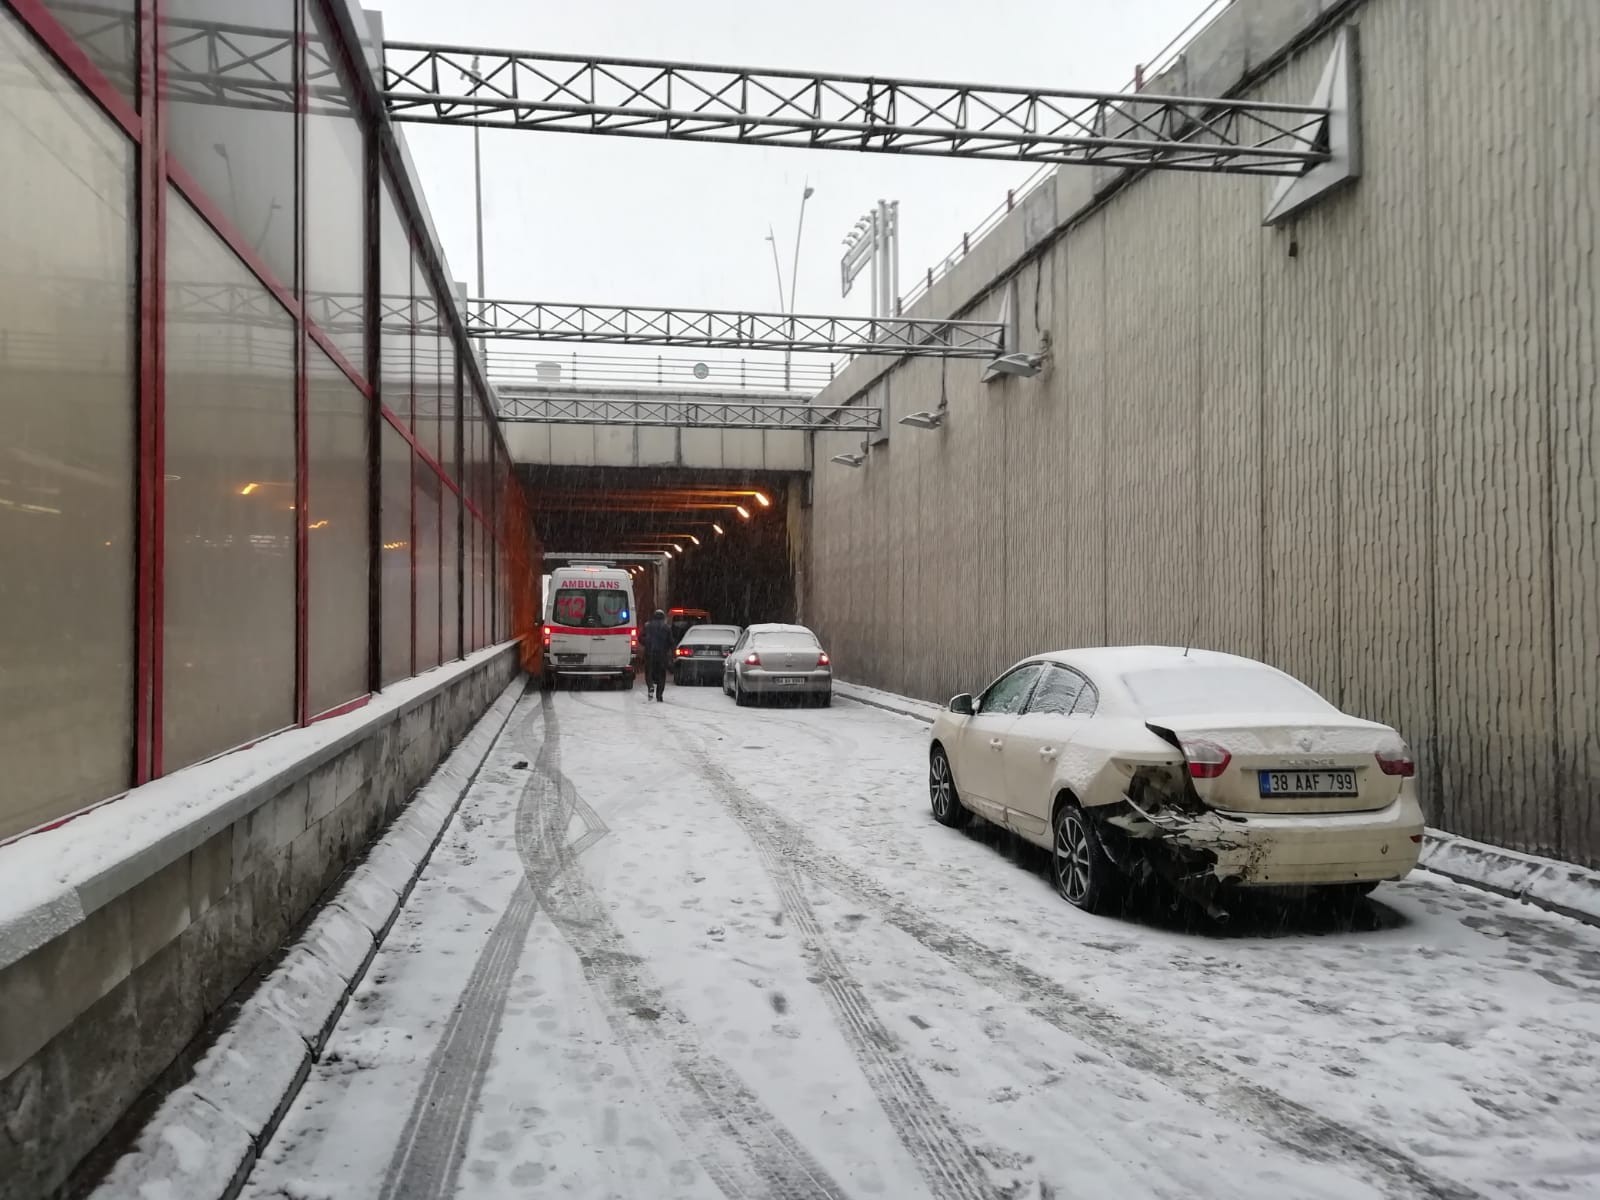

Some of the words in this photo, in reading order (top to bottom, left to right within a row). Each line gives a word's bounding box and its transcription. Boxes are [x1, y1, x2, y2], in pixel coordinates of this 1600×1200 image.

[561, 580, 620, 589] AMBULANS
[558, 597, 585, 618] 112
[1271, 774, 1288, 791] 38
[1295, 773, 1320, 791] AAF
[1328, 773, 1353, 790] 799
